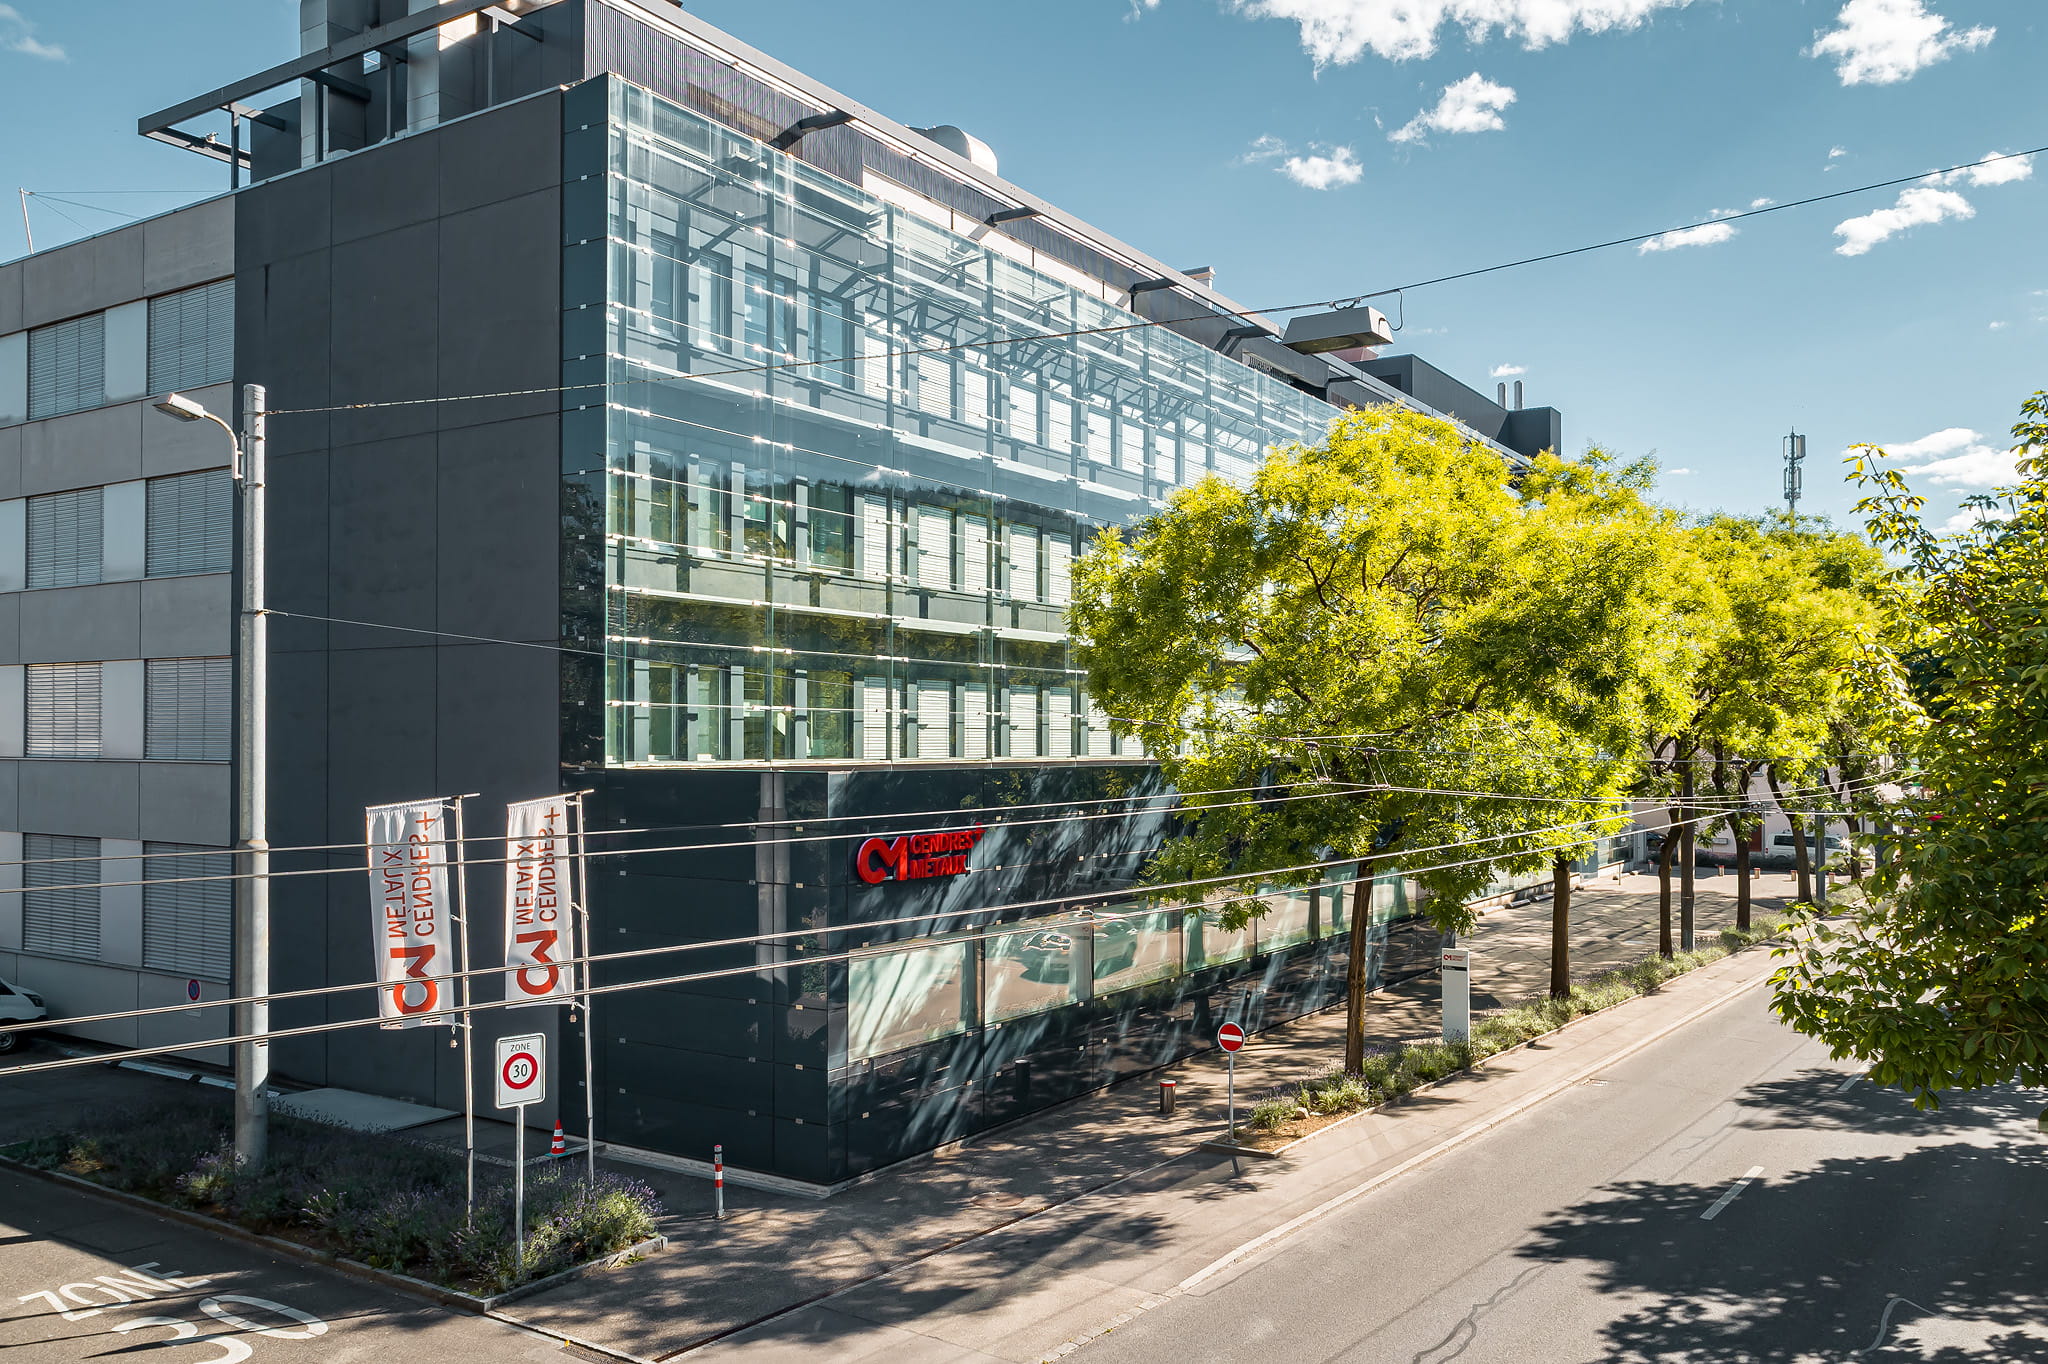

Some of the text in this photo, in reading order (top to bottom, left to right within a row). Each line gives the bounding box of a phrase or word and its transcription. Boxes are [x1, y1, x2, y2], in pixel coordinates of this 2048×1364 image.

[909, 853, 968, 879] MÉTAUX
[511, 1043, 531, 1052] ZONE
[513, 1064, 528, 1078] 30
[17, 1262, 212, 1322] ZONE
[110, 1295, 329, 1364] 30
